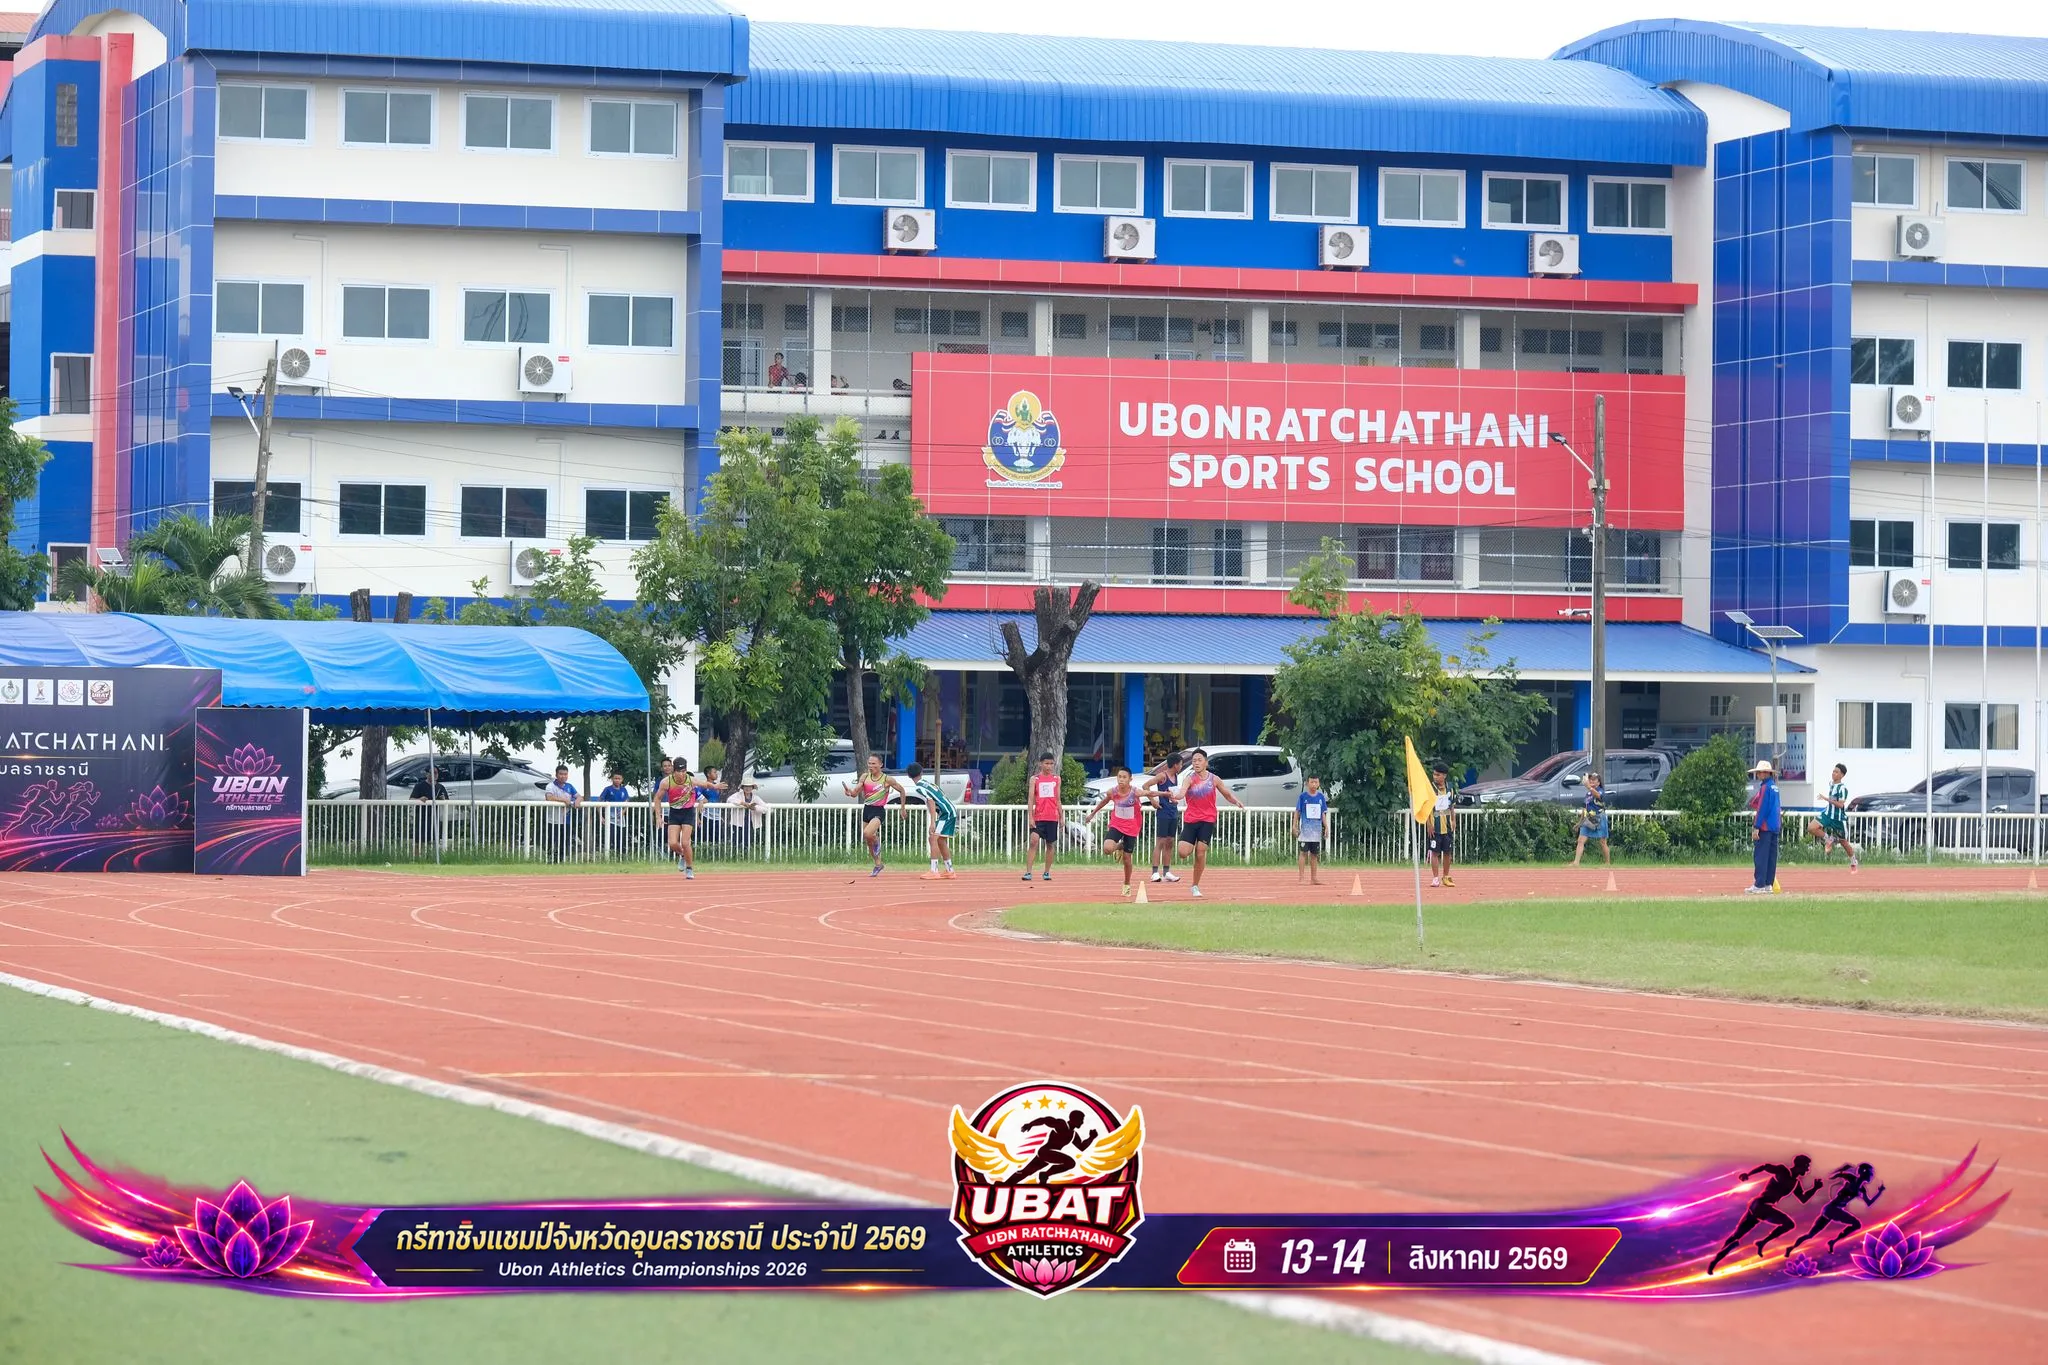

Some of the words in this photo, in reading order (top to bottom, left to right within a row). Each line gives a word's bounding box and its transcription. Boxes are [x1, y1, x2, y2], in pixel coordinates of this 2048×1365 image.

[1119, 401, 1549, 448] UBONRATCHATHANI
[1169, 452, 1330, 491] SPORTS
[1355, 458, 1515, 495] SCHOOL
[0, 732, 164, 751] ATCHATHANI
[212, 776, 290, 793] UBON
[213, 793, 286, 803] ATHLETICS
